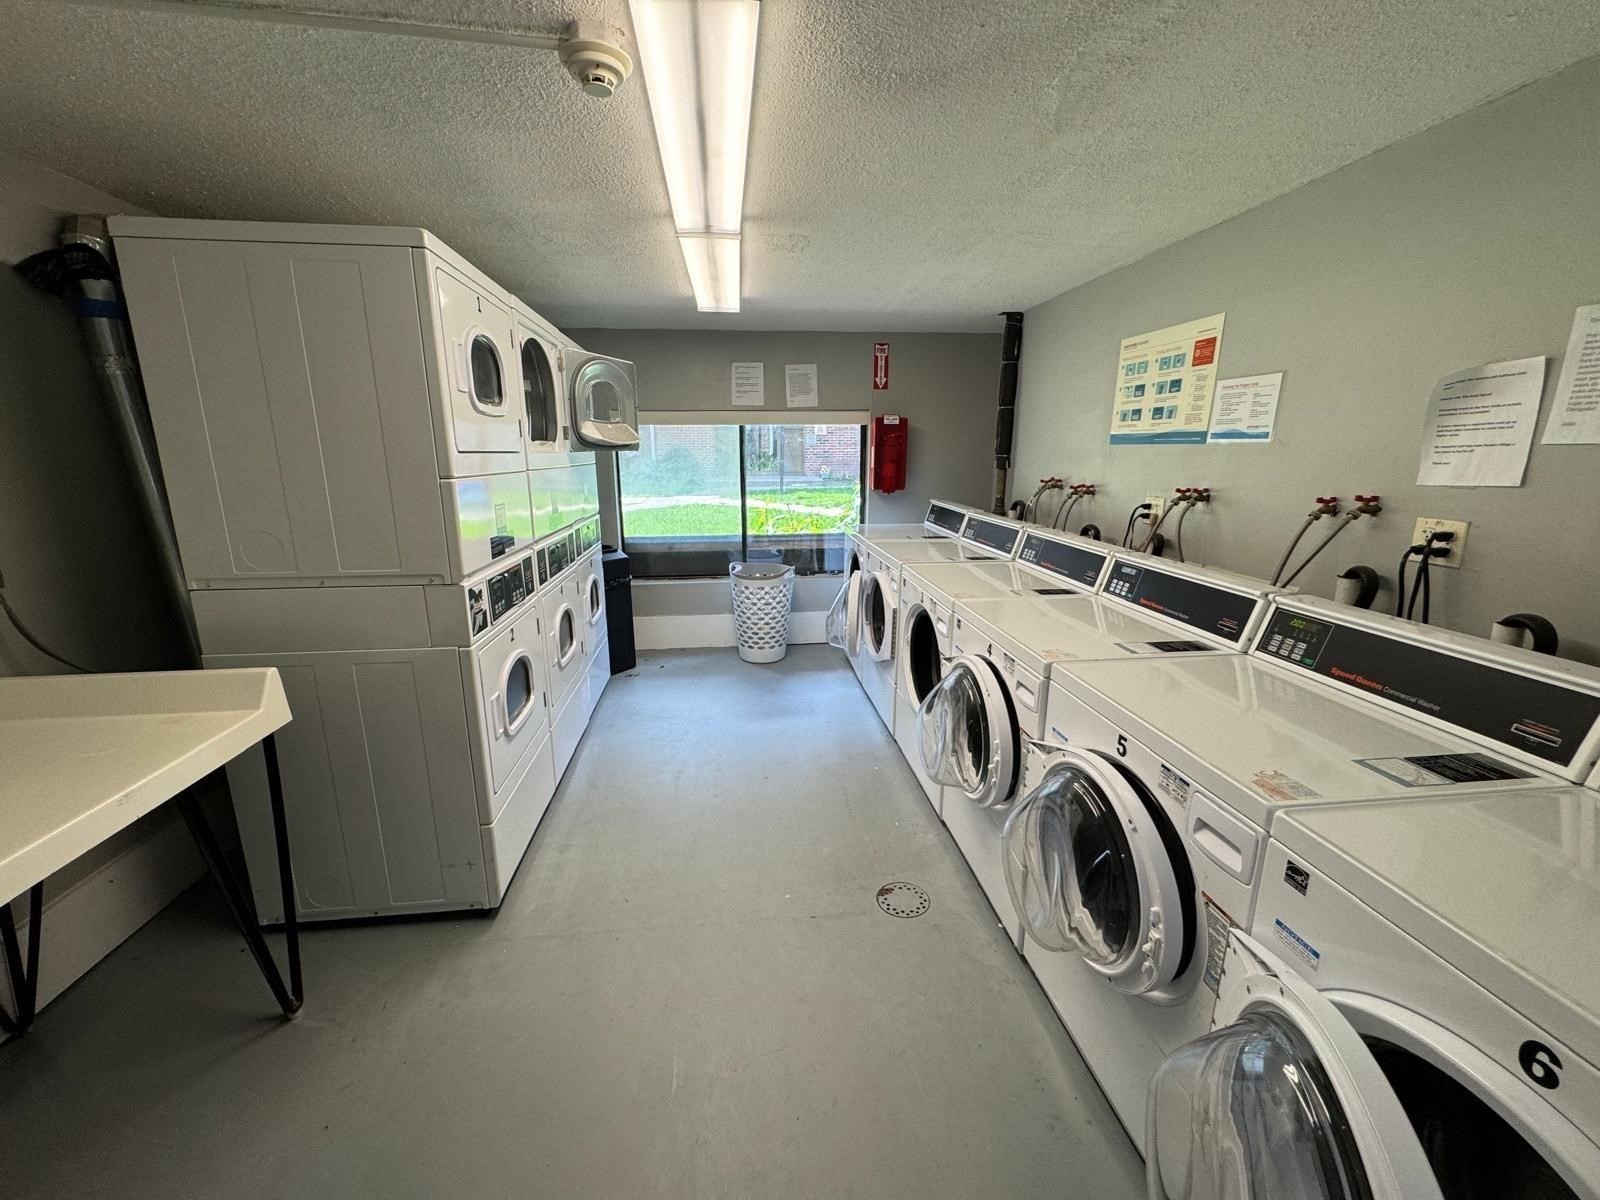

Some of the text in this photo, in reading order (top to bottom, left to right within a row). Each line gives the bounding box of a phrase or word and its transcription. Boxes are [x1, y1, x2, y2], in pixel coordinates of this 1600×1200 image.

[476, 296, 482, 313] 1
[876, 347, 887, 355] FIRE
[509, 627, 516, 643] 2
[986, 643, 992, 658] 4
[1330, 667, 1357, 681] Speed
[1383, 686, 1418, 704] Commercial
[1417, 697, 1441, 711] Washer
[1116, 733, 1128, 758] 5
[1517, 1038, 1564, 1091] 6
